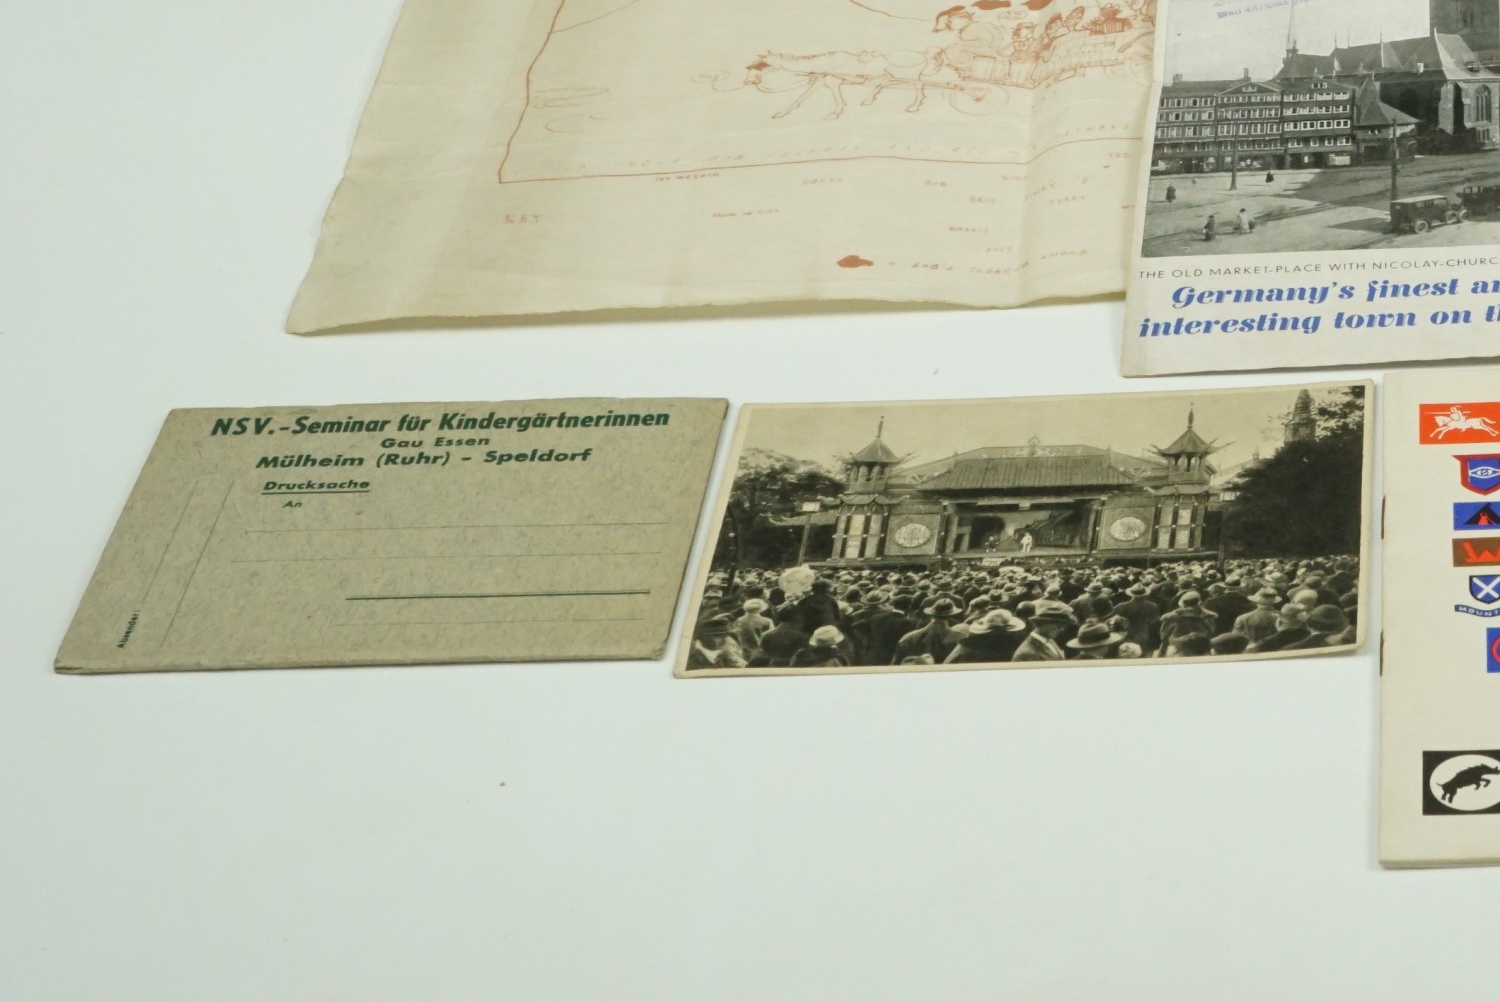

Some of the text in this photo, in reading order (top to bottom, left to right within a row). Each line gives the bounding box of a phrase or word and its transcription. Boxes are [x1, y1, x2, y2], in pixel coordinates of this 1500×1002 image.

[504, 214, 541, 224] KEY
[1138, 270, 1165, 278] THE
[1171, 269, 1203, 278] OLD
[1209, 263, 1322, 276] MARKET-PLACE
[1329, 262, 1366, 271] WITH
[1171, 281, 1355, 309] Germany's
[1366, 278, 1459, 302] finest
[1139, 312, 1322, 338] interesting
[1334, 310, 1417, 330] town
[1430, 309, 1472, 326] on
[210, 410, 670, 436] NSV.-Seminar für Kindergärtnerinnen
[380, 436, 490, 448] Gau Essen
[255, 454, 364, 469] Mülheim
[376, 452, 451, 469] (Ruhr)
[483, 448, 593, 466] Speldorf
[263, 480, 371, 492] Drucksache
[282, 500, 303, 509] An
